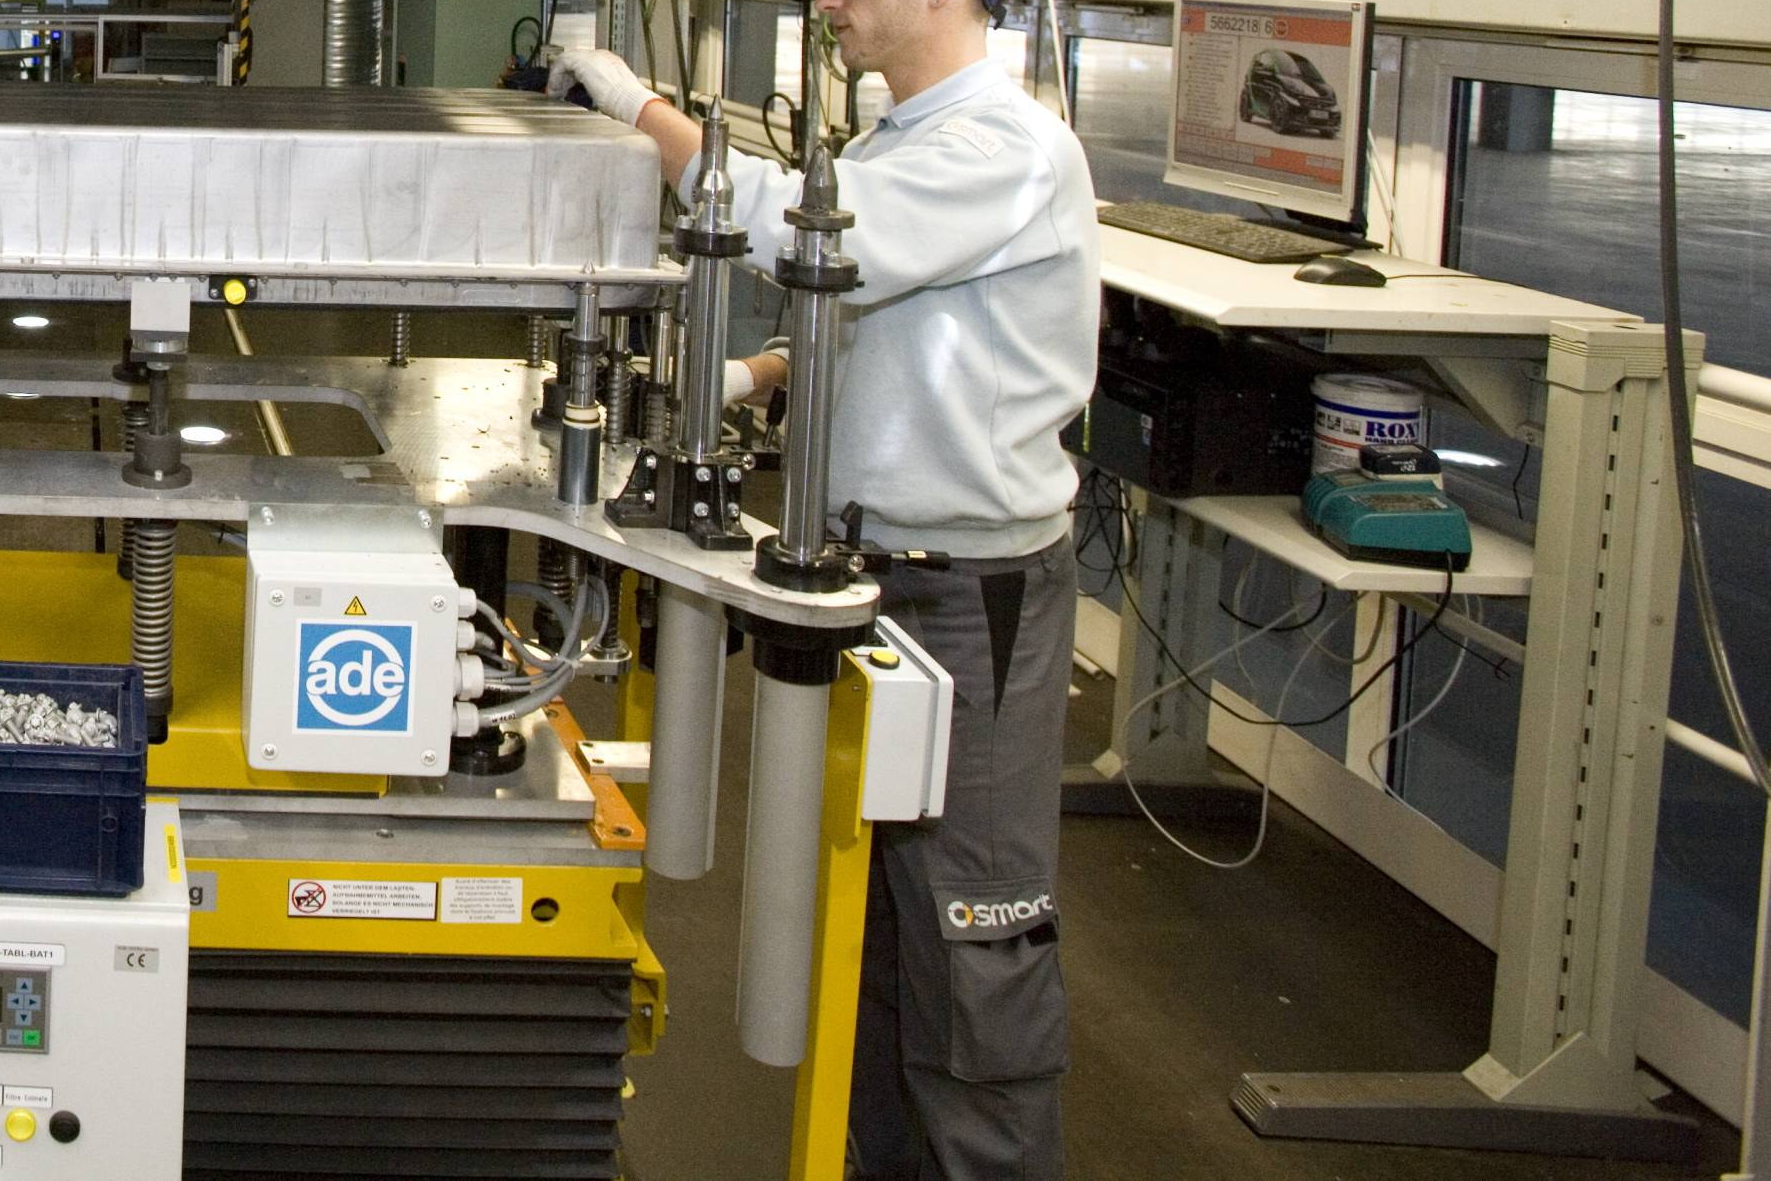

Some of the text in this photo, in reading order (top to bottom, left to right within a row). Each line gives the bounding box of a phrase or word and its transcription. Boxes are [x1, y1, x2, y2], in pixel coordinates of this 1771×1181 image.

[1210, 15, 1259, 34] 5662218
[306, 650, 405, 698] ade
[973, 893, 1053, 927] smart
